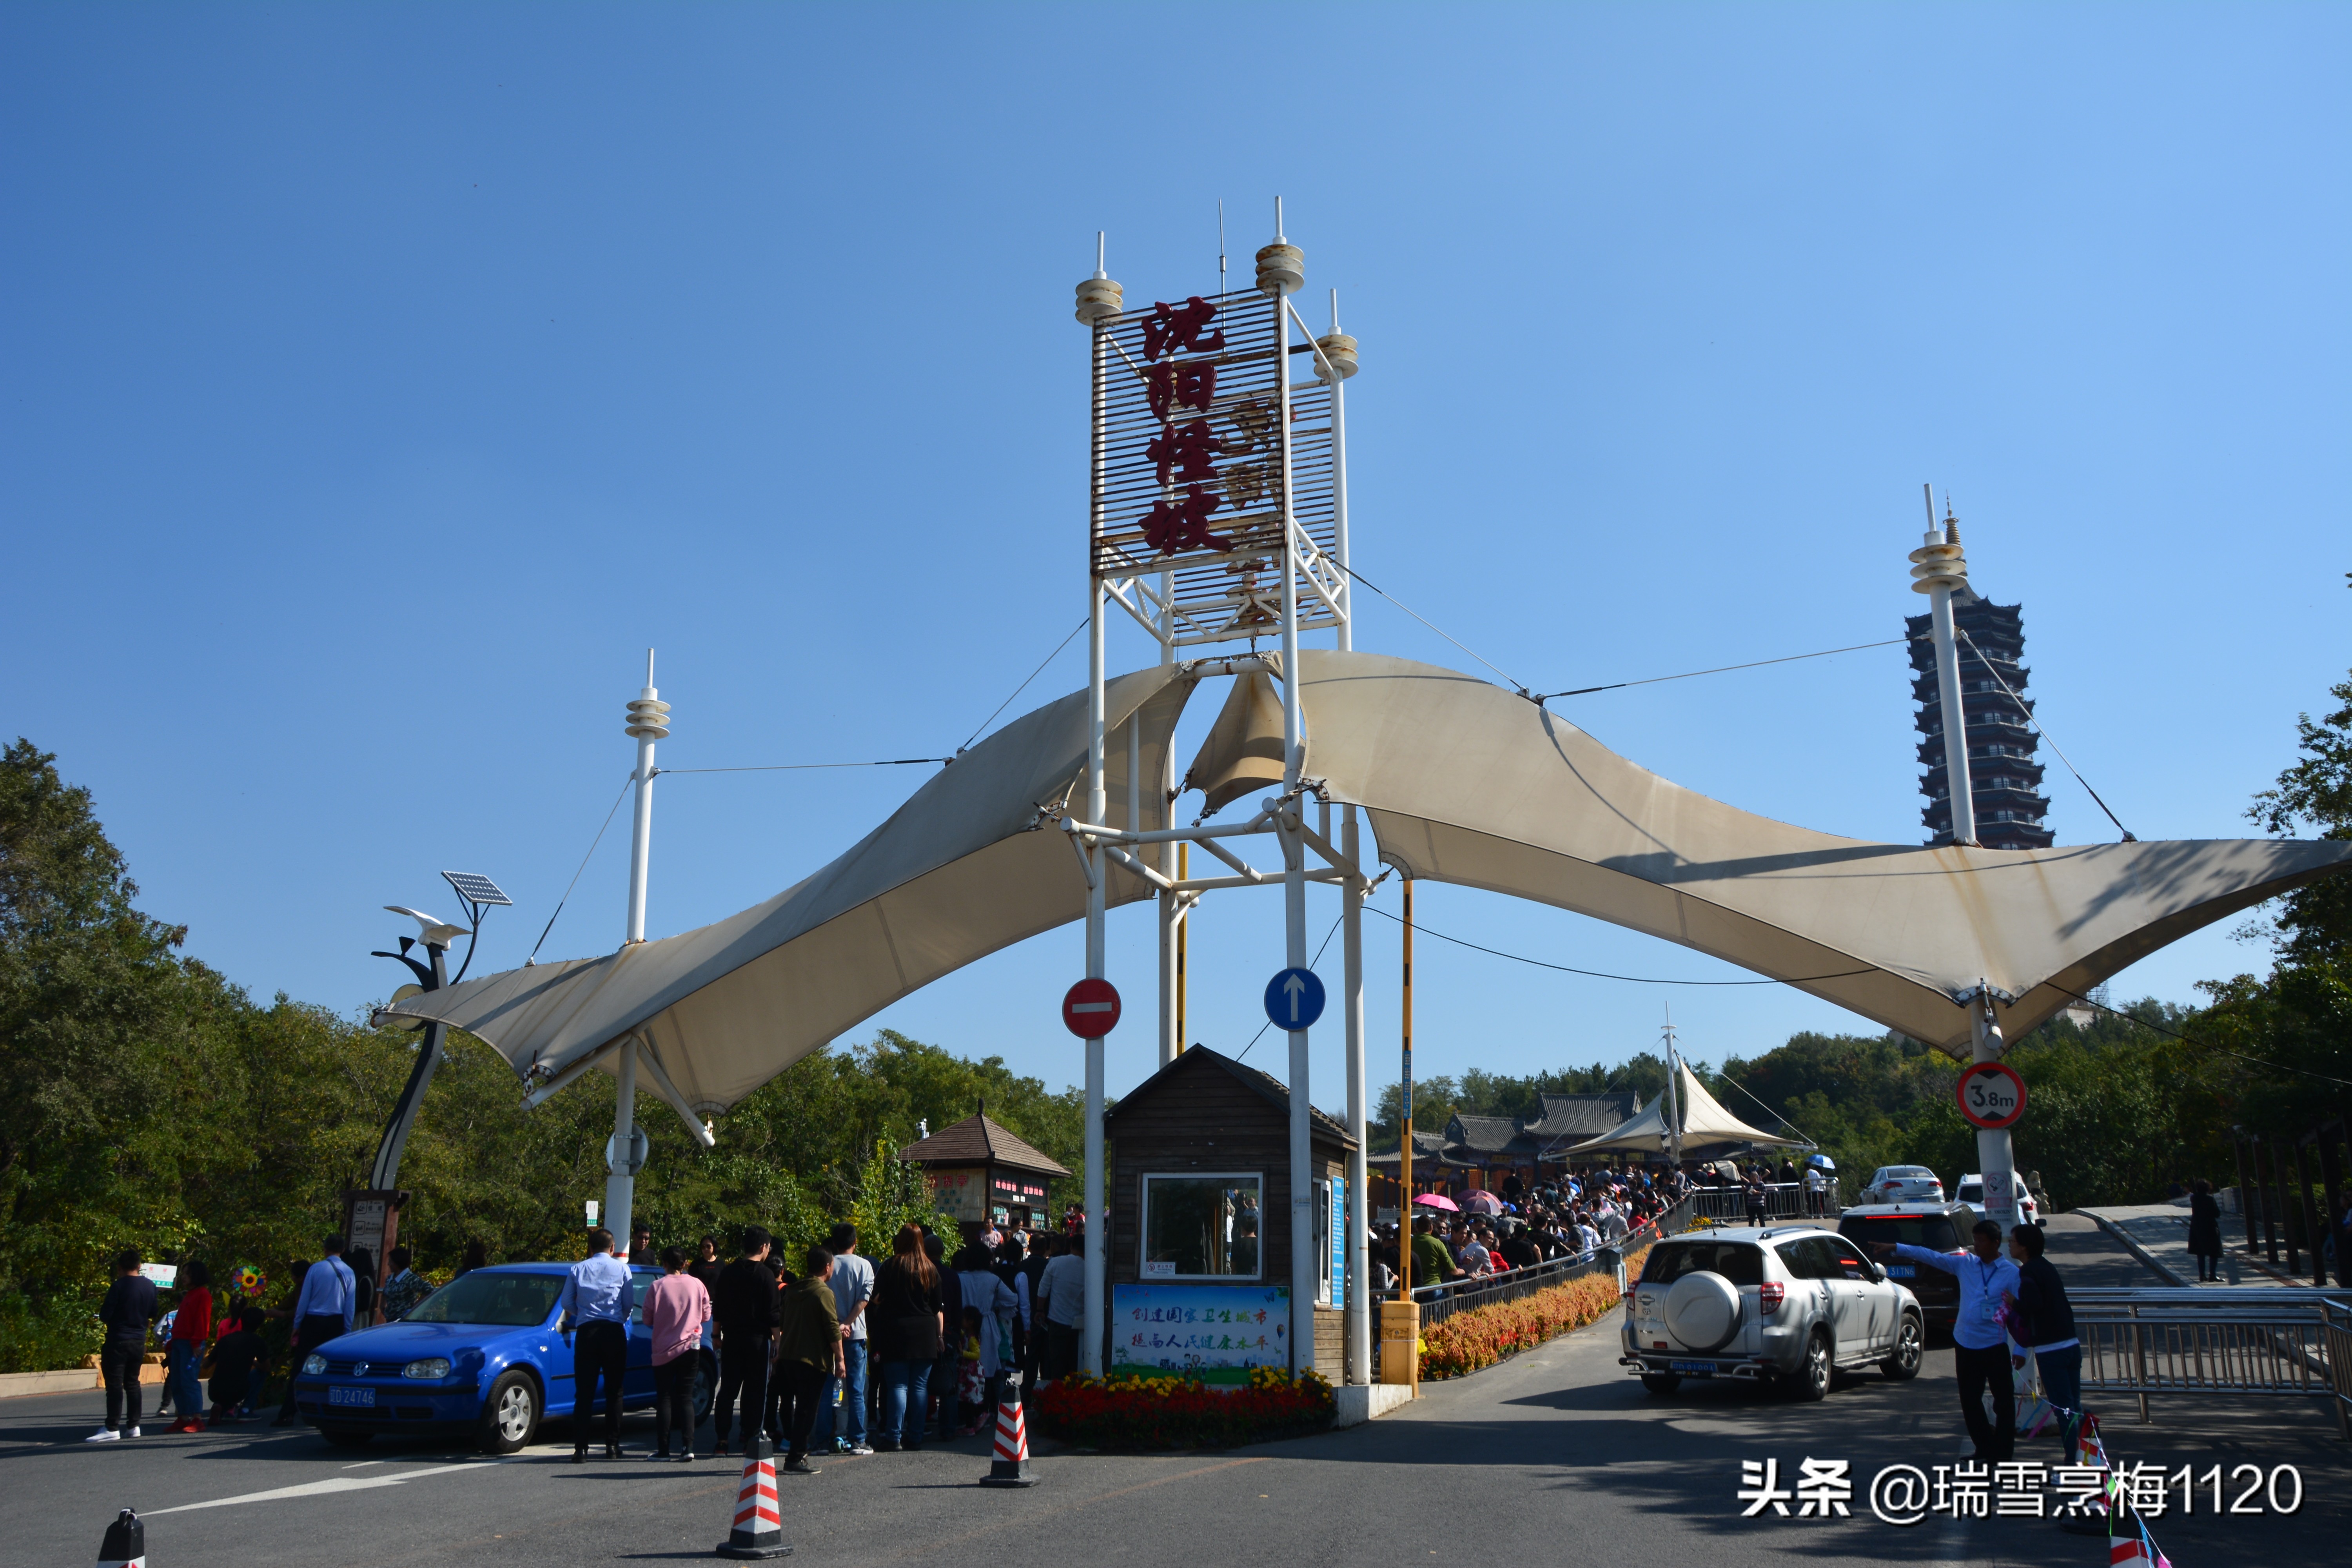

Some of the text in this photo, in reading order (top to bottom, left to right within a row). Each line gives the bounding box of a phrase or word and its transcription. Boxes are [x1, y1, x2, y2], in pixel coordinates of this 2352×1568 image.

[1971, 1085, 2014, 1107] 3.8m
[1132, 1307, 1267, 1325] 创建国家卫生城市
[1131, 1332, 1269, 1350] 提高人民健康水平
